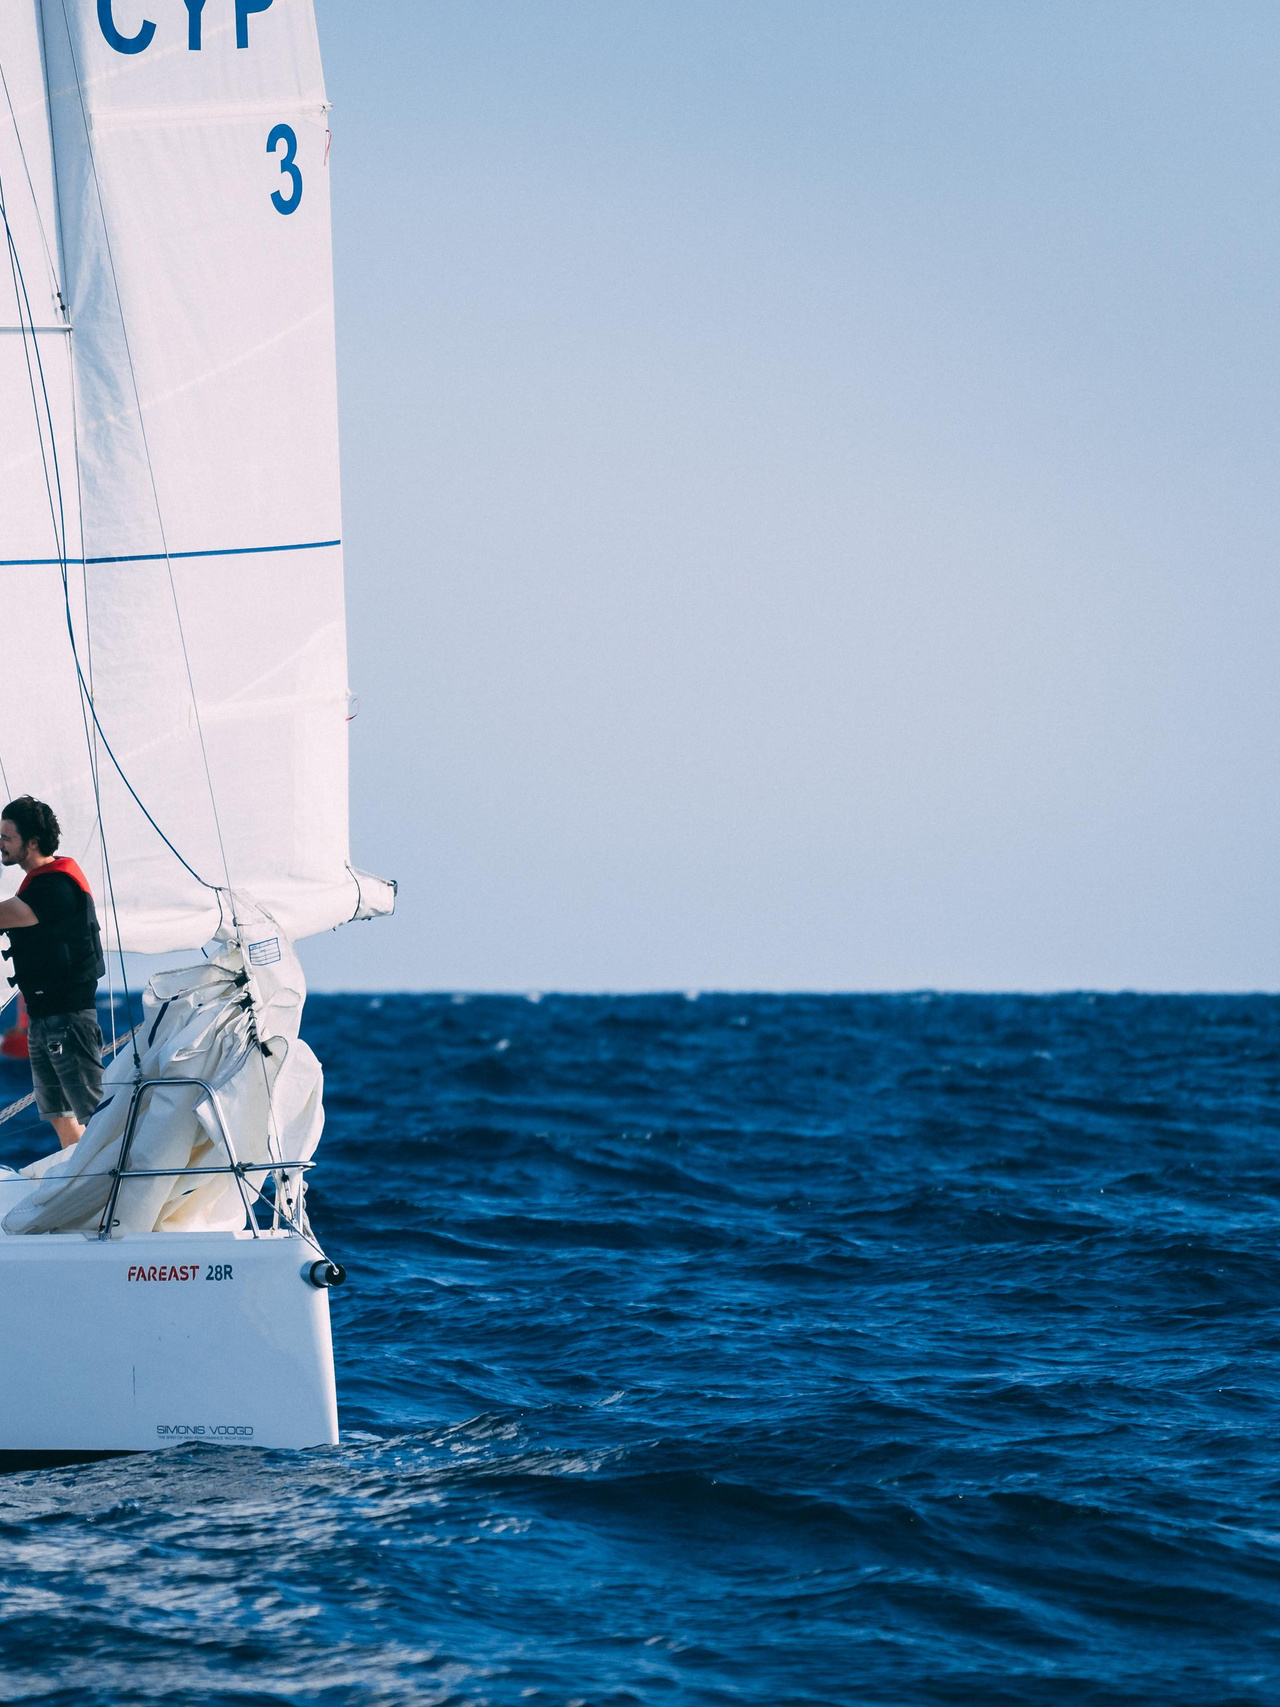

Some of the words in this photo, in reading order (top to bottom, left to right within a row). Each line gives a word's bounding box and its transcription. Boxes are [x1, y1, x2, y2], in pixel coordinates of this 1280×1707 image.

[96, 0, 273, 55] CYP
[266, 123, 303, 215] 3
[127, 1265, 200, 1282] FAREAST
[205, 1264, 234, 1281] 28R
[156, 1425, 206, 1435] SIMONIS
[209, 1425, 254, 1436] VOOGD
